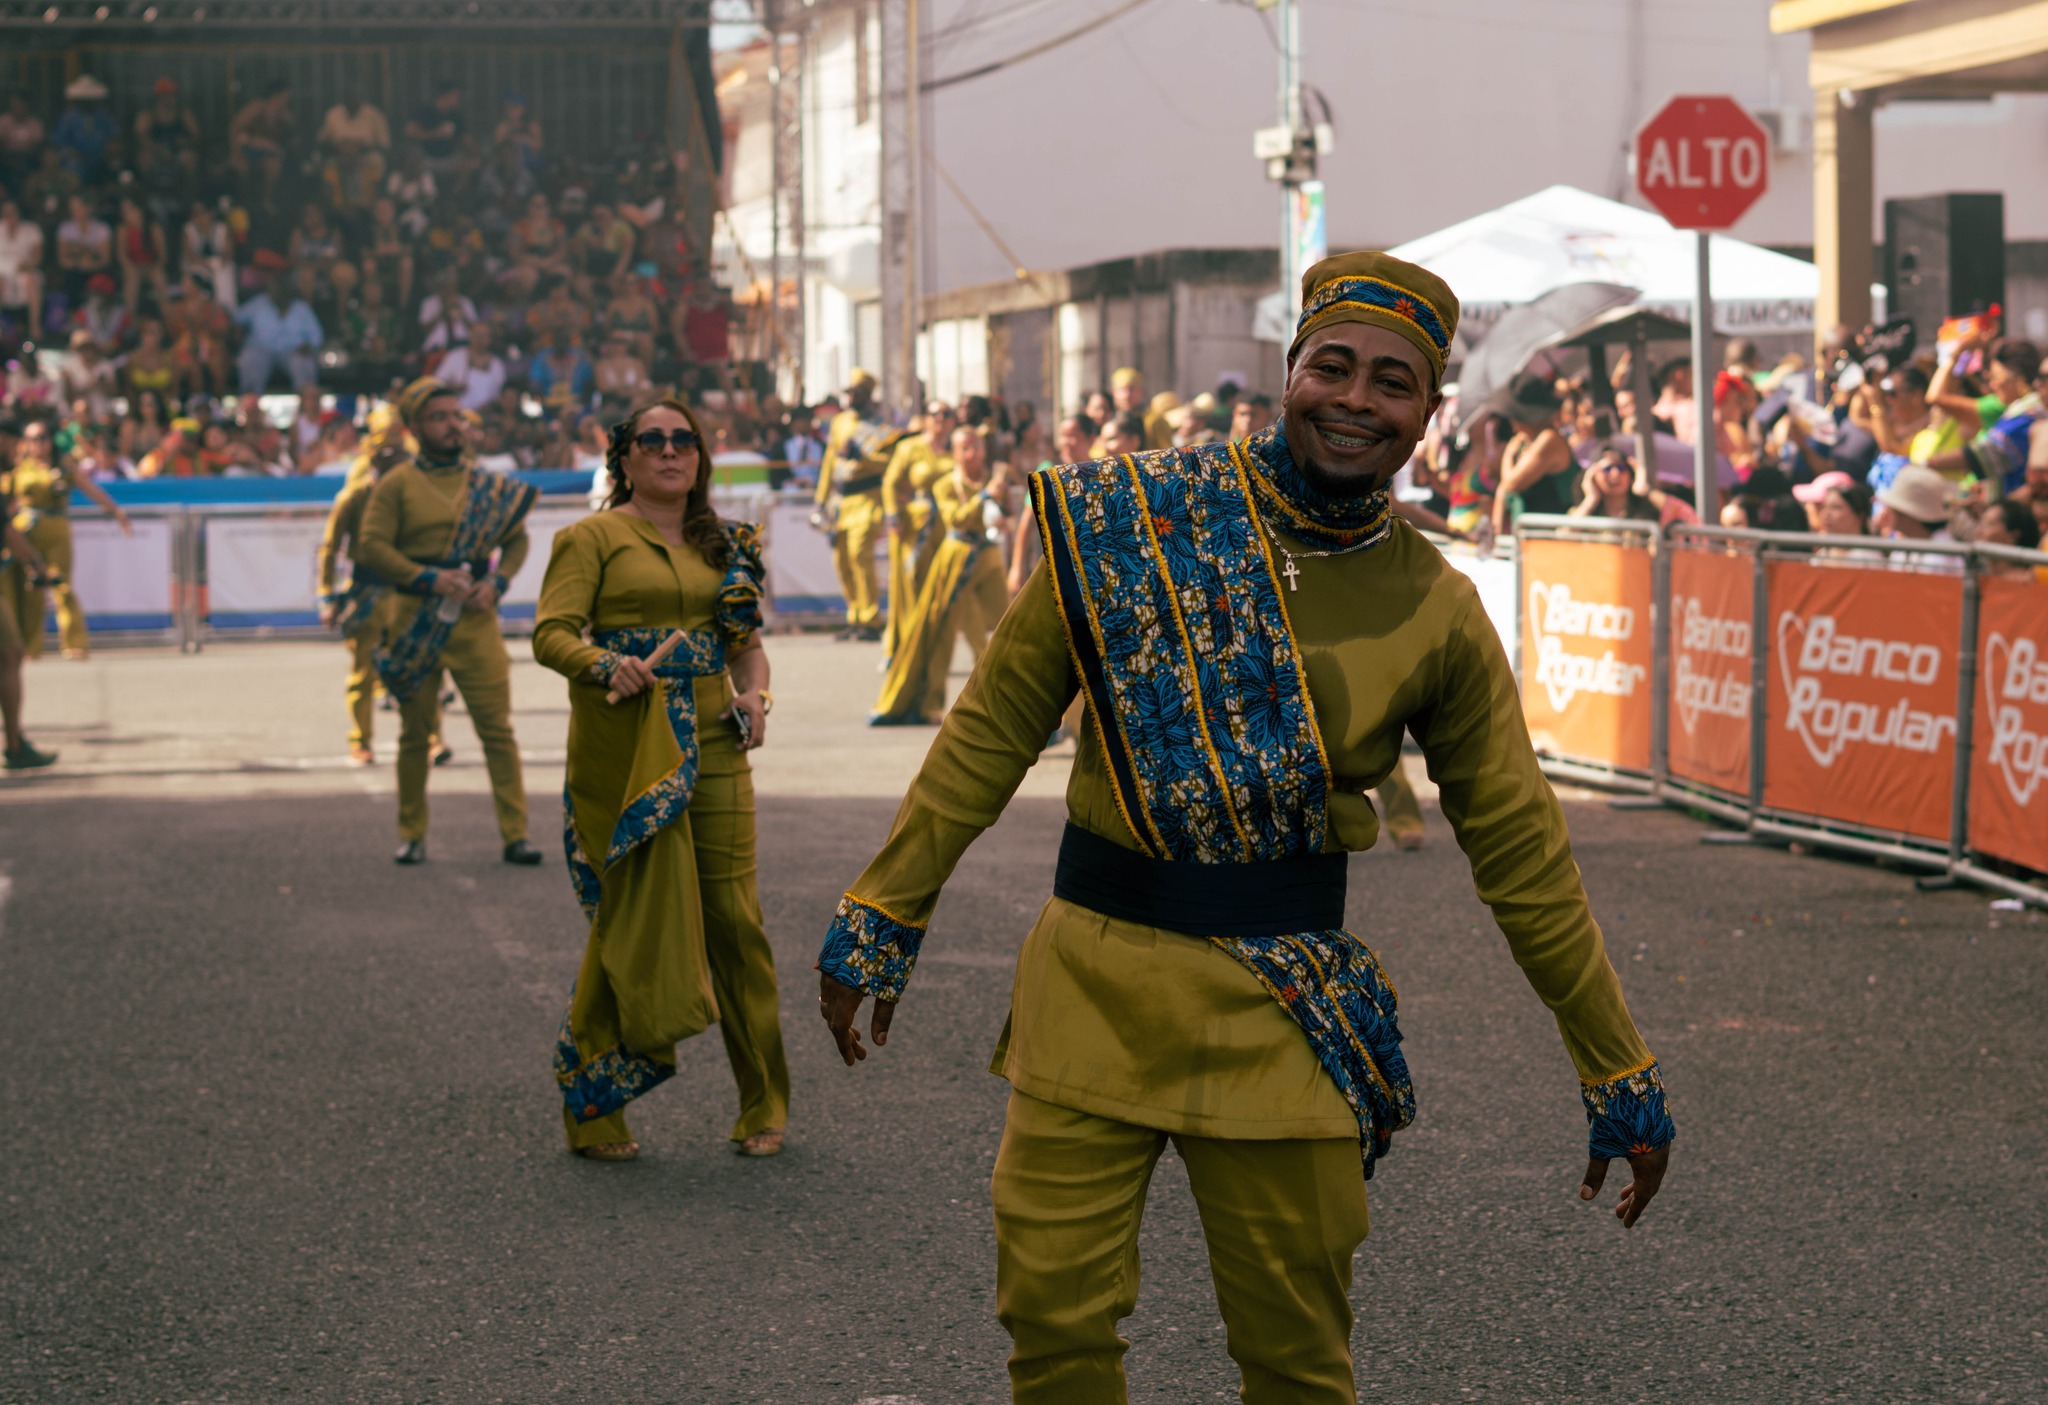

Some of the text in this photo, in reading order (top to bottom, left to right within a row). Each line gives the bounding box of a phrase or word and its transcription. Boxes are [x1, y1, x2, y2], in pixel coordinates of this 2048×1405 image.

[1646, 137, 1761, 188] ALTO
[1543, 583, 1634, 640] Banco
[1682, 597, 1750, 657] Banco
[1535, 634, 1645, 696] Popular
[1799, 615, 1941, 685] Banco
[1785, 677, 1957, 753] Popular
